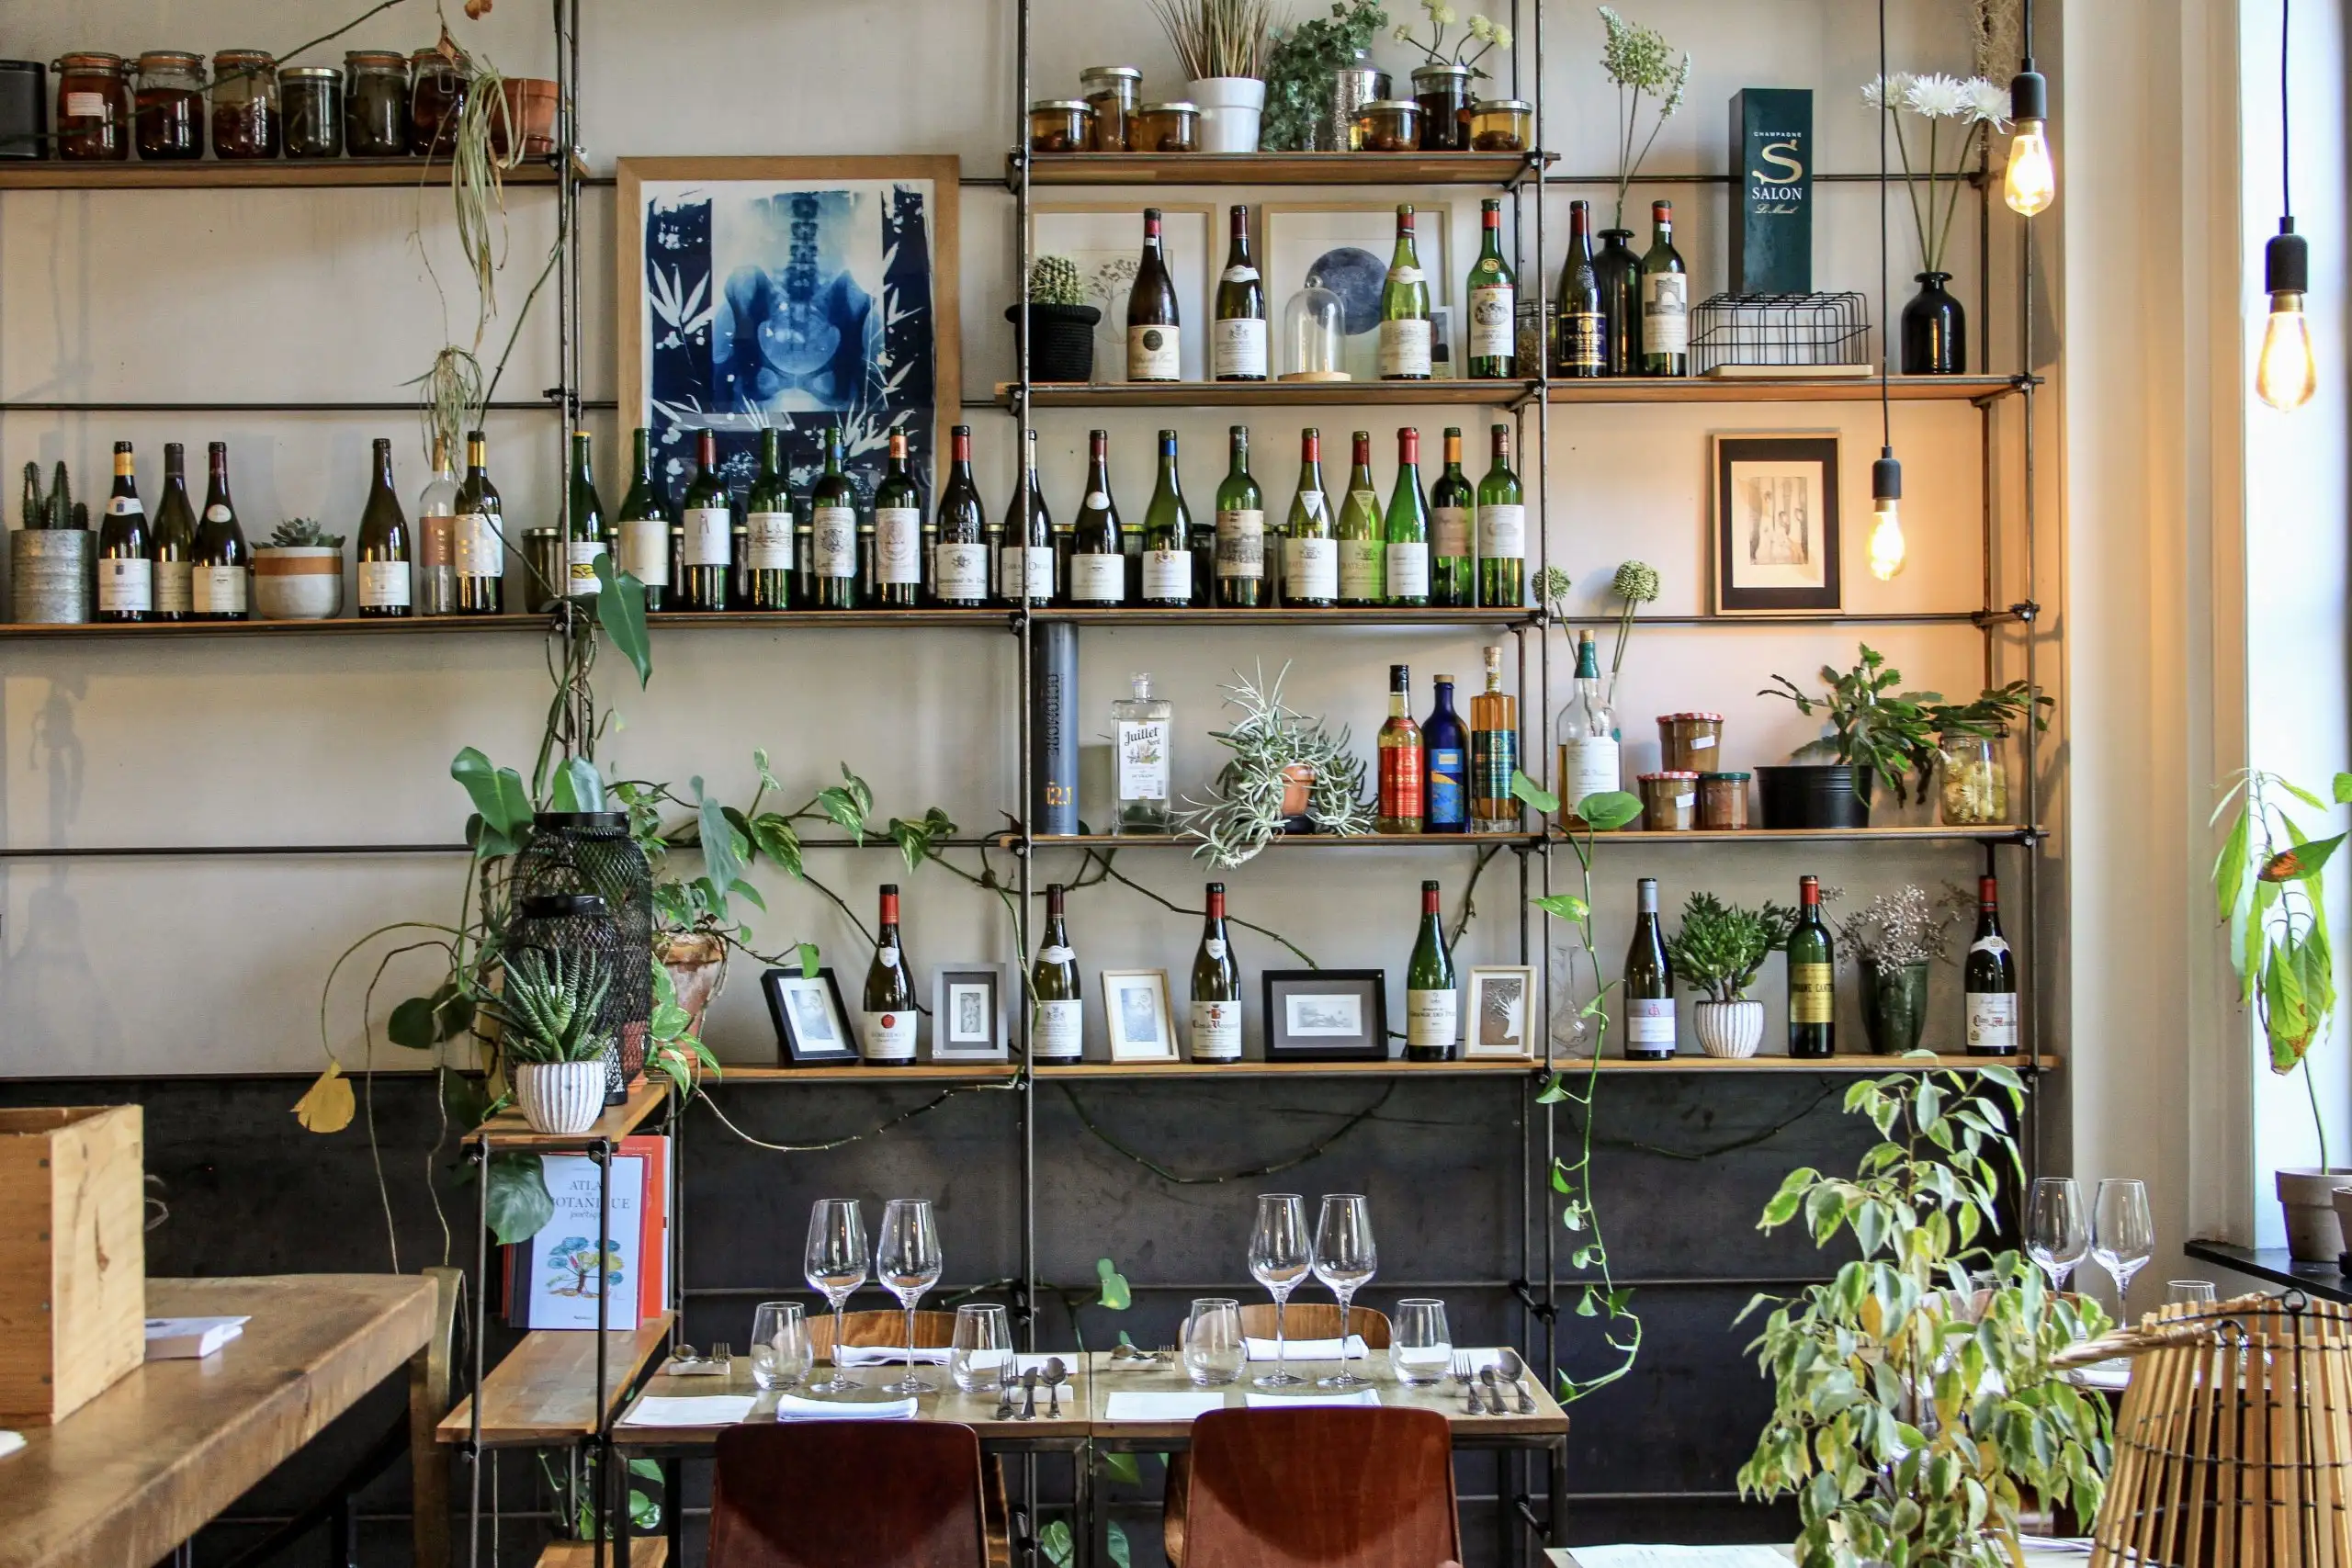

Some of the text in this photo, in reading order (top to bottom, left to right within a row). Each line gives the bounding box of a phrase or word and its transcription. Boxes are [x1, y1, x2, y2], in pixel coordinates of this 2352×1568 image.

[1751, 139, 1803, 185] S
[1752, 186, 1803, 200] SALON
[1124, 727, 1161, 746] Juillet
[569, 1179, 602, 1191] ATLA
[551, 1196, 630, 1210] OTANIUE
